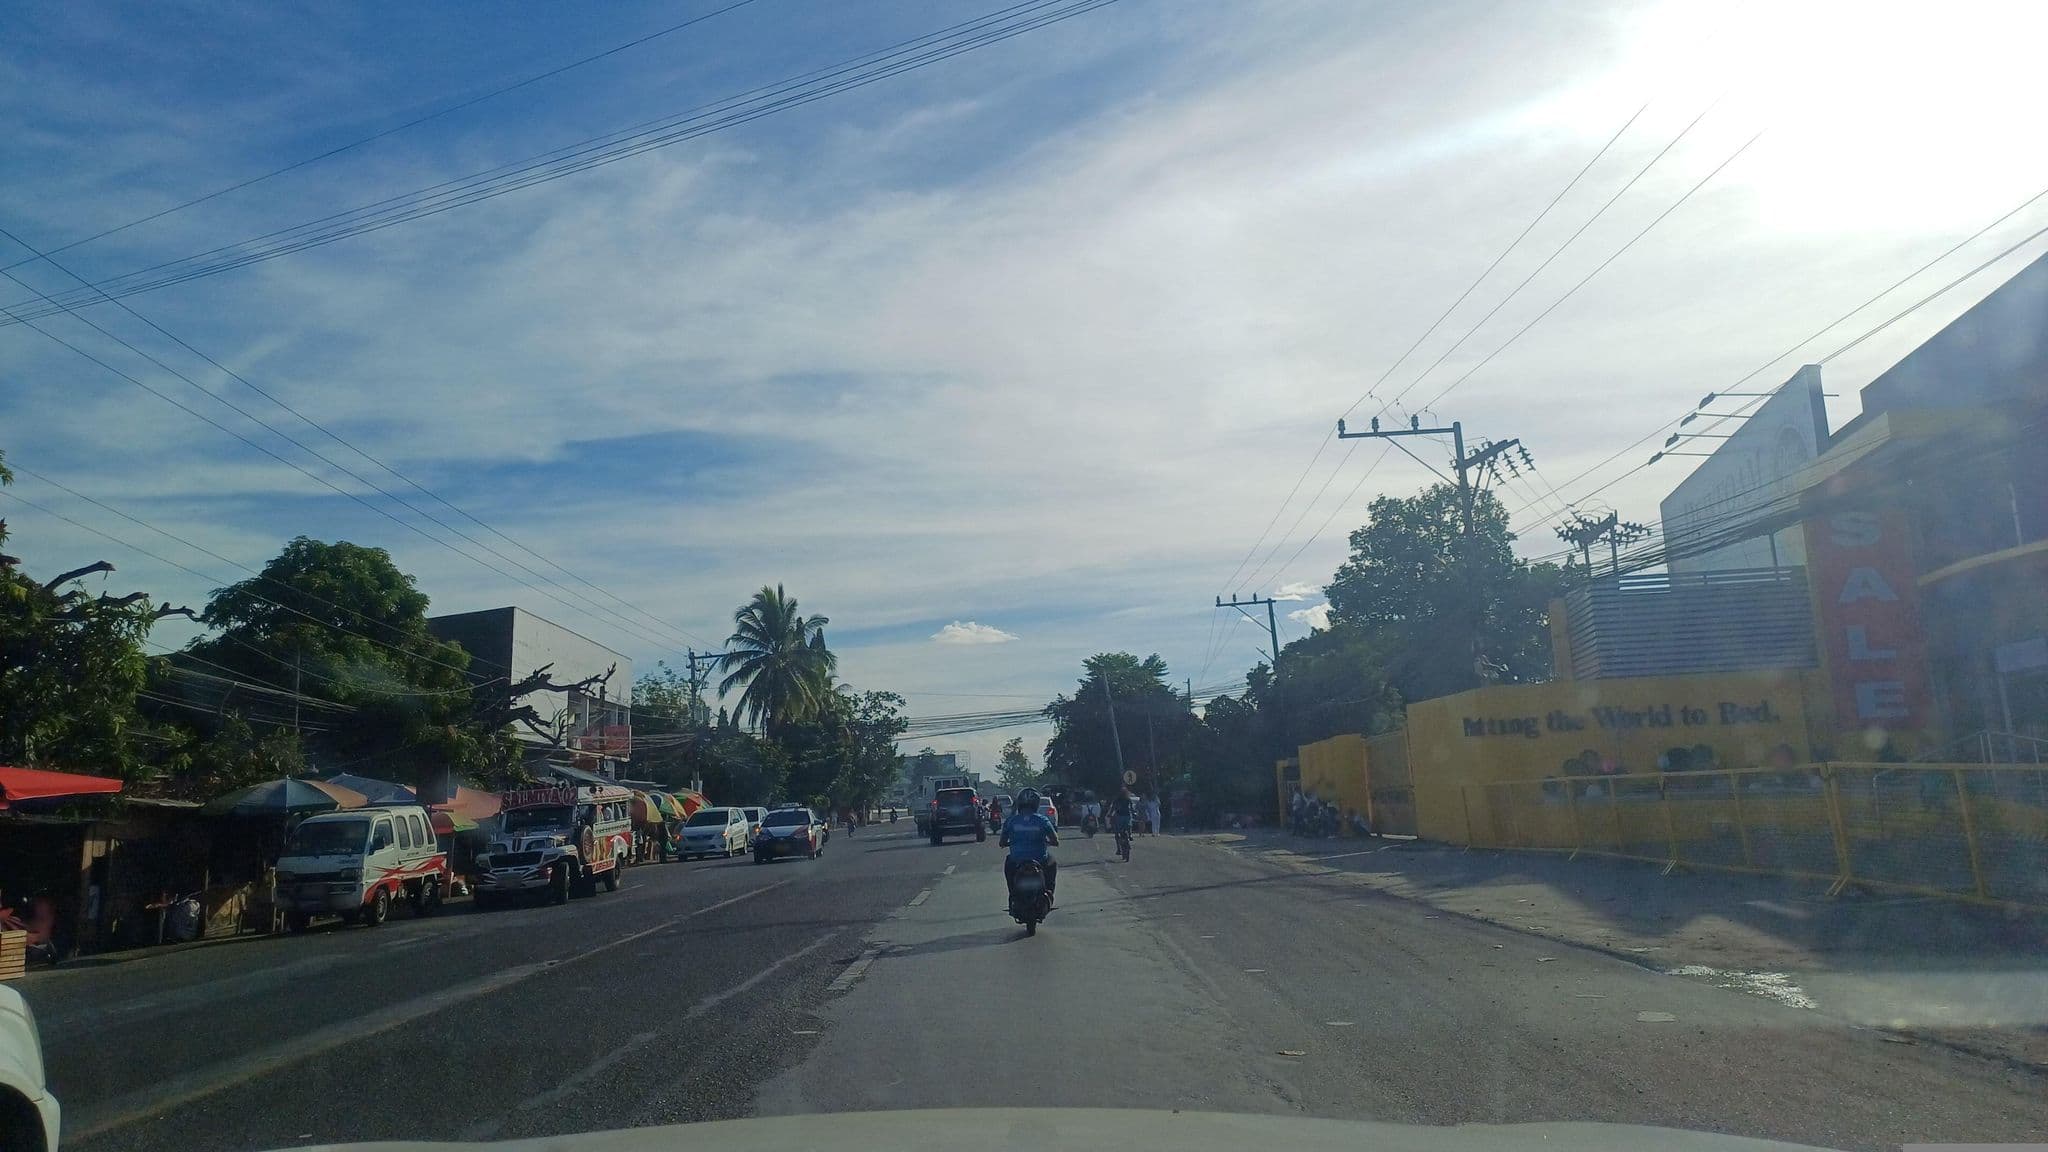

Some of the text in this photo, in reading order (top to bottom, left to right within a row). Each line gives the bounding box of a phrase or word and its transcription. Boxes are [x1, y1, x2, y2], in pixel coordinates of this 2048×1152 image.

[1830, 511, 1909, 720] SALE
[1545, 709, 1585, 732] the
[1591, 703, 1673, 729] World
[1680, 703, 1708, 727] to
